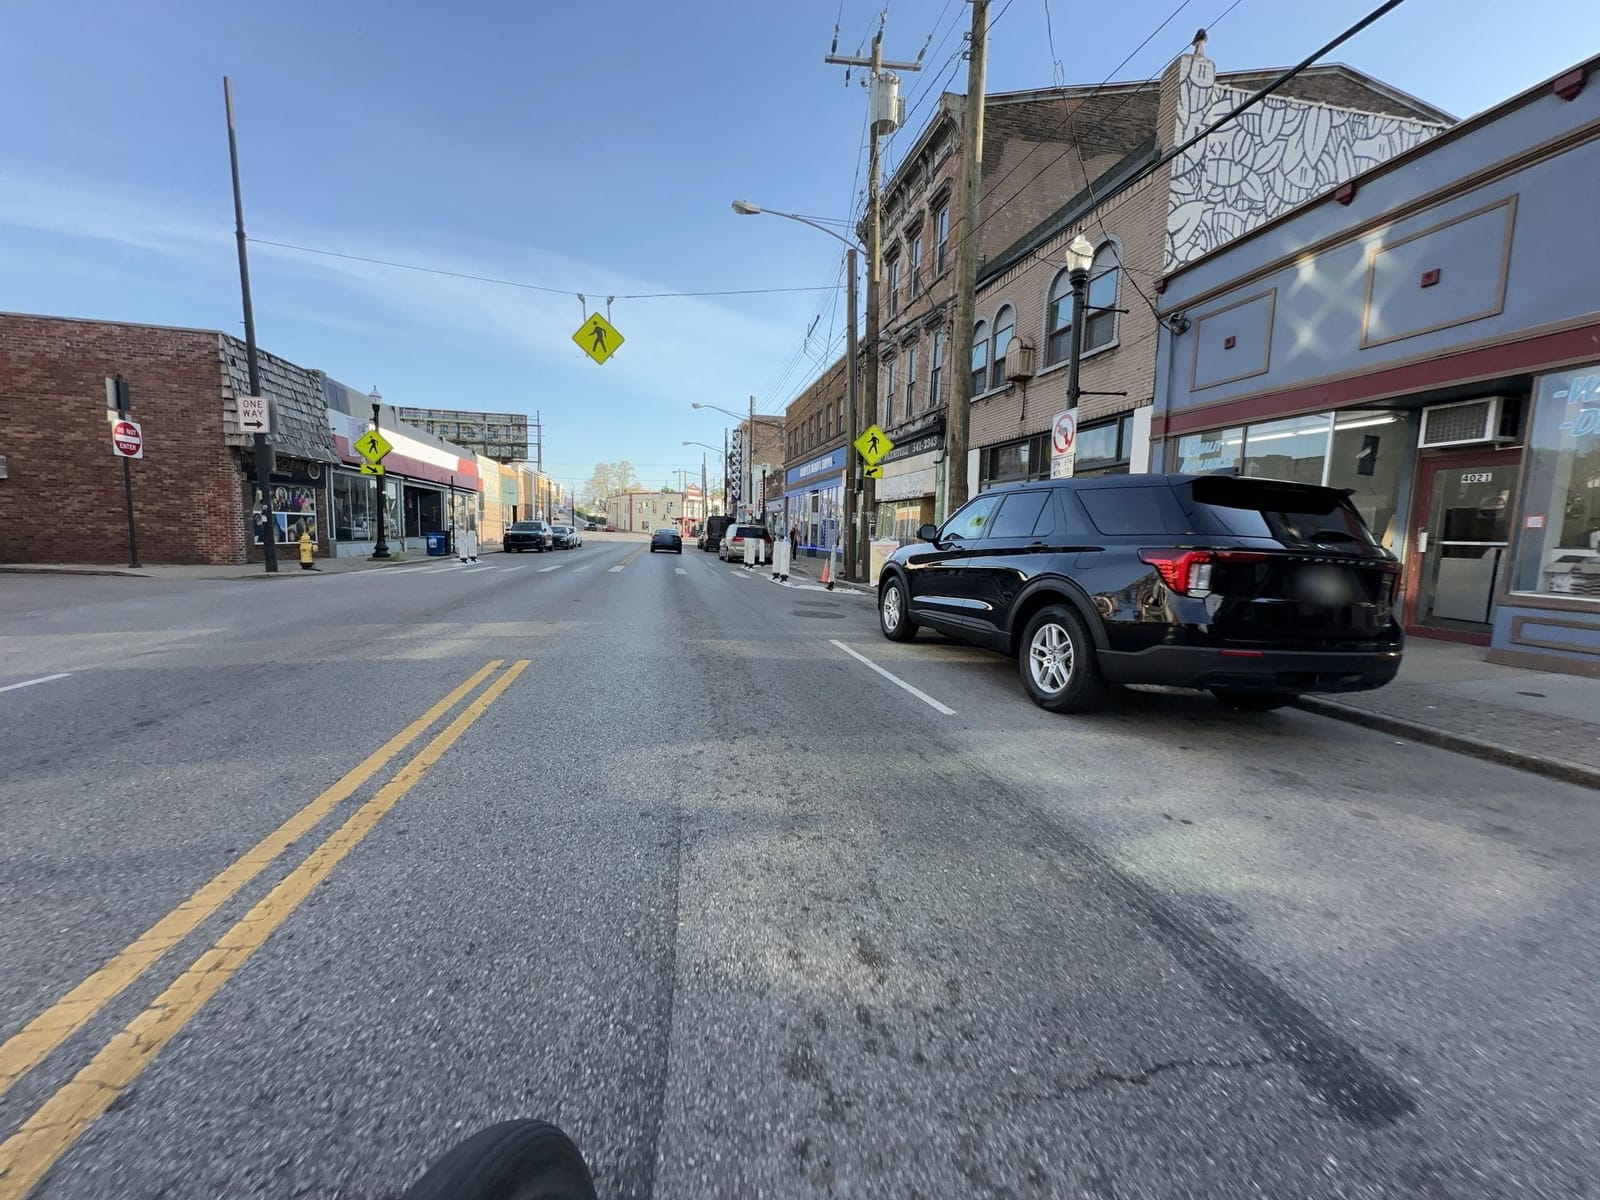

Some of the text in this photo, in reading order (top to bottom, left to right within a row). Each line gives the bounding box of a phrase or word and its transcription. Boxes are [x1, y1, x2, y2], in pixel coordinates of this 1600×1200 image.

[243, 400, 263, 408] ONE
[243, 409, 264, 418] WAY
[116, 426, 136, 436] DO NOT
[120, 442, 136, 451] ENTER
[1462, 473, 1491, 483] 4021
